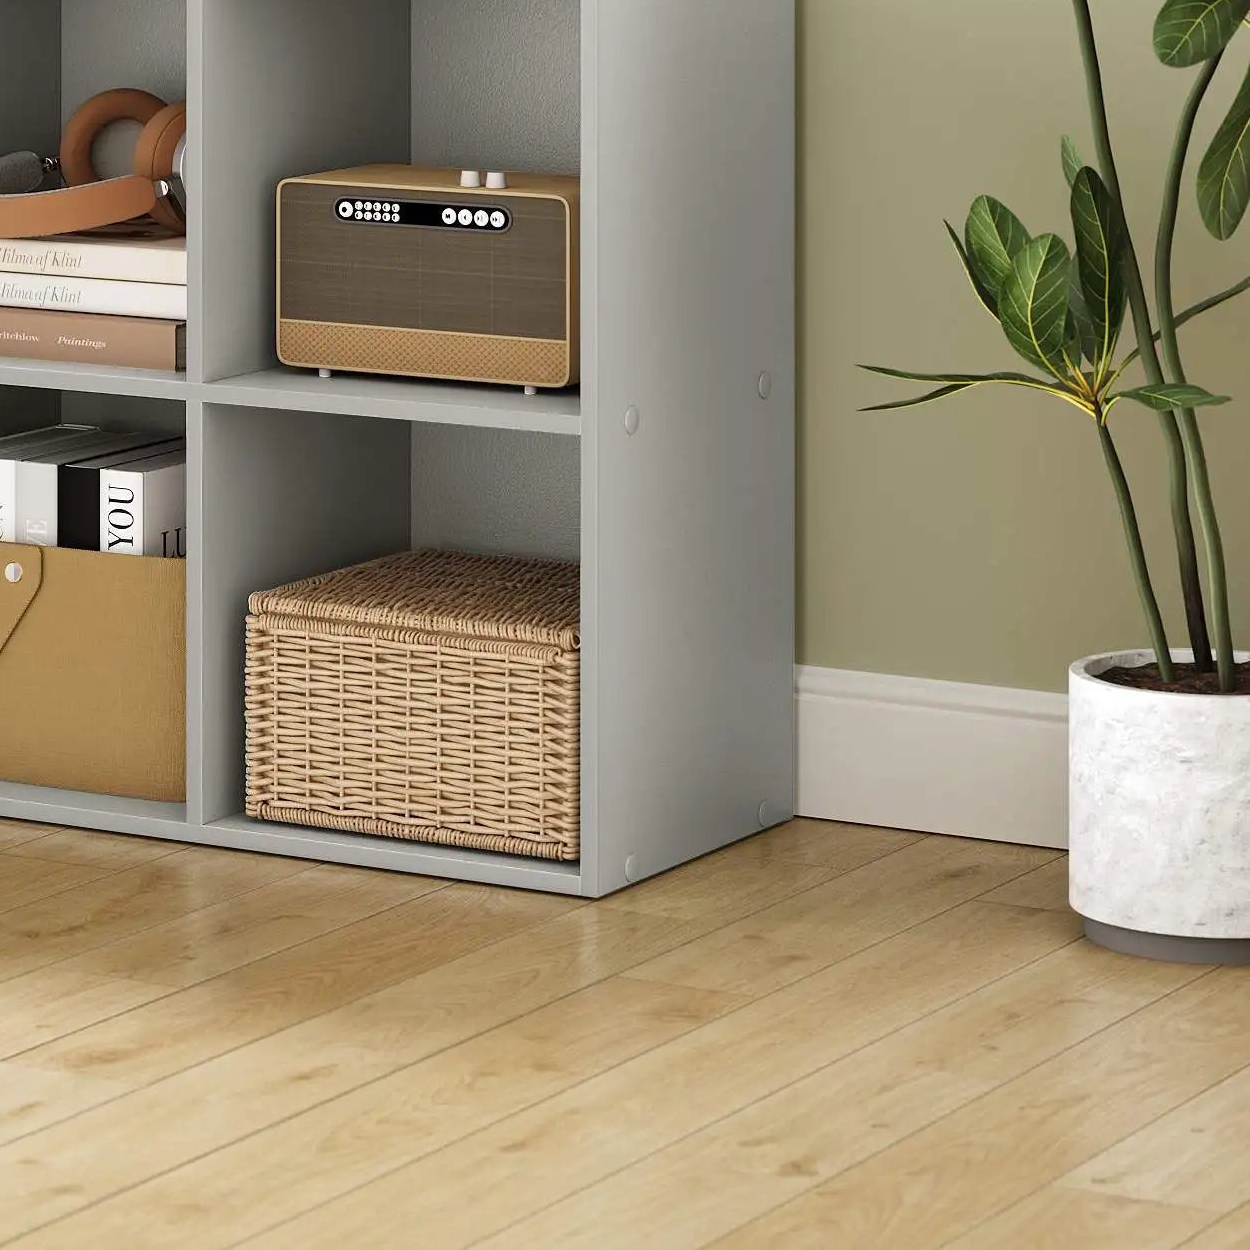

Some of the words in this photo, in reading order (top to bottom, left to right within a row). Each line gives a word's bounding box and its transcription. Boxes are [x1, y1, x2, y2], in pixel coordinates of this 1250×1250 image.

[34, 248, 52, 271] af
[51, 249, 82, 269] Klint
[33, 283, 51, 307] af
[50, 285, 82, 304] Klint
[57, 335, 107, 349] Paintings
[107, 484, 135, 550] YOU
